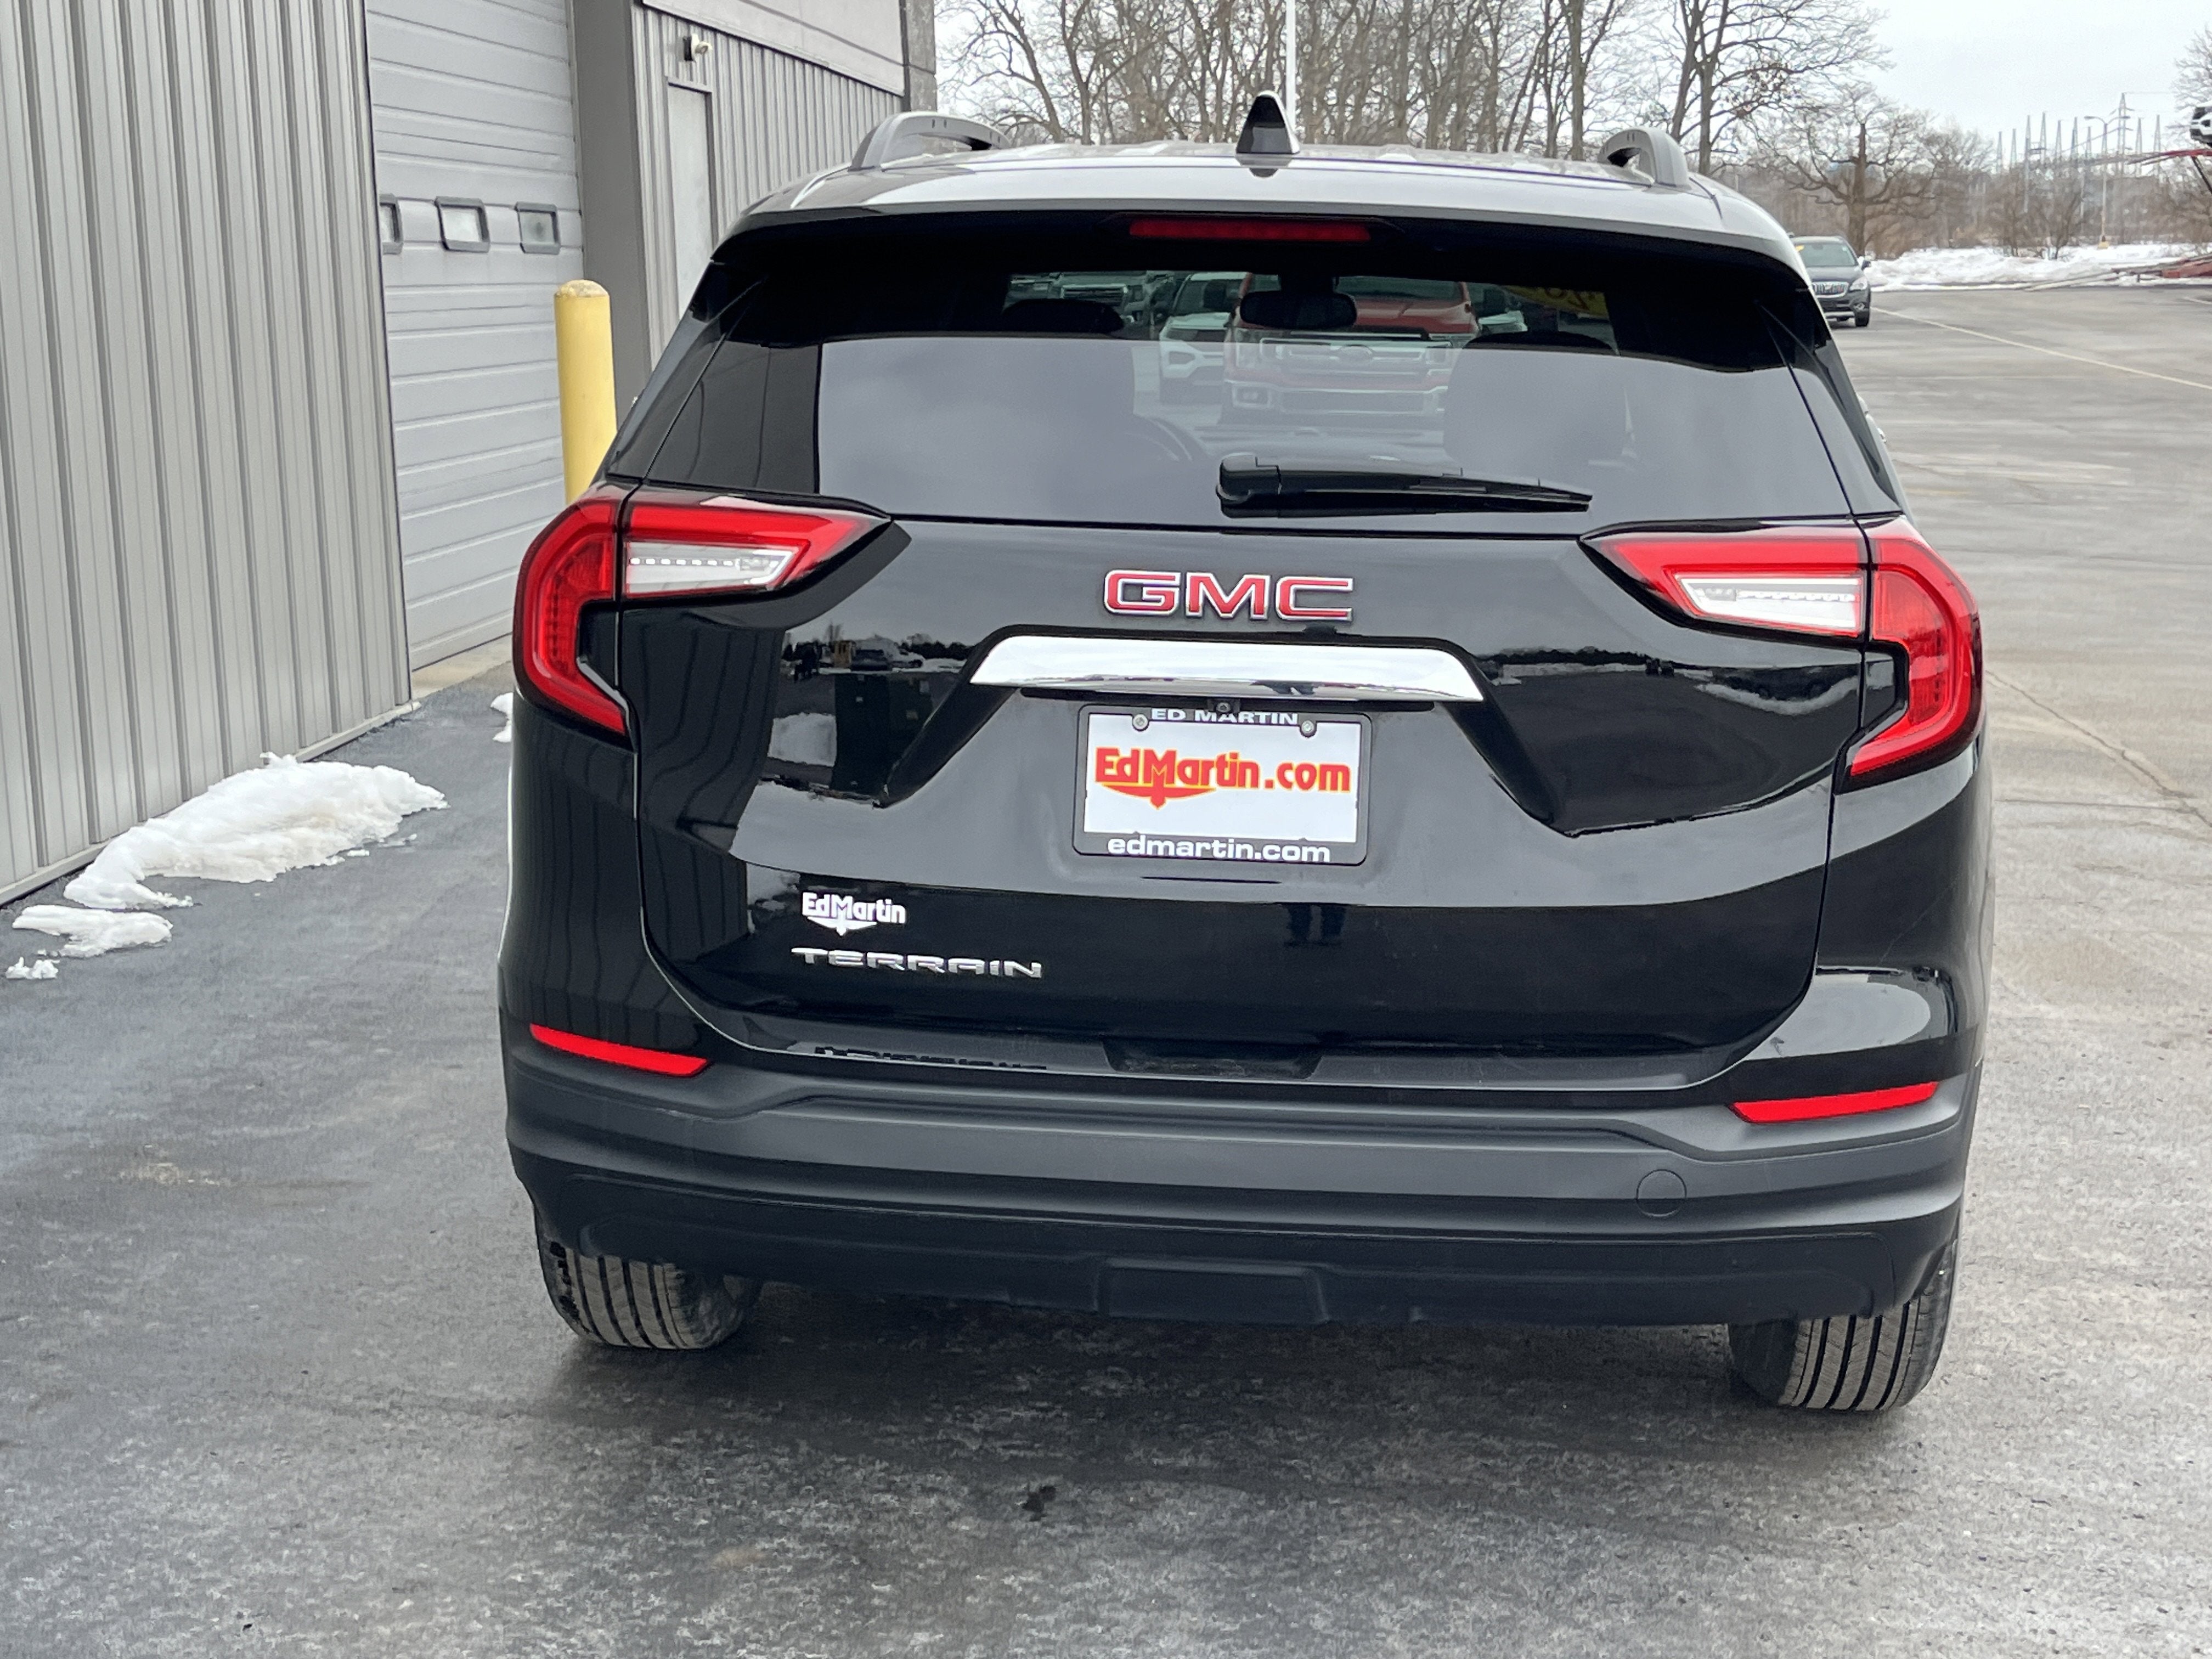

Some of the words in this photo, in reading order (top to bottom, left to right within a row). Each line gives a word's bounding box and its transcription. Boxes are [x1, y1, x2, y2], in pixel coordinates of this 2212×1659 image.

[1104, 569, 1354, 622] GMC
[1151, 707, 1186, 720] ED
[1194, 709, 1299, 725] MARTIN
[1095, 747, 1351, 792] EdMartin.com
[1107, 834, 1330, 863] edmartin.com
[802, 892, 906, 924] EdMartin
[791, 947, 1042, 978] TERRAIN
